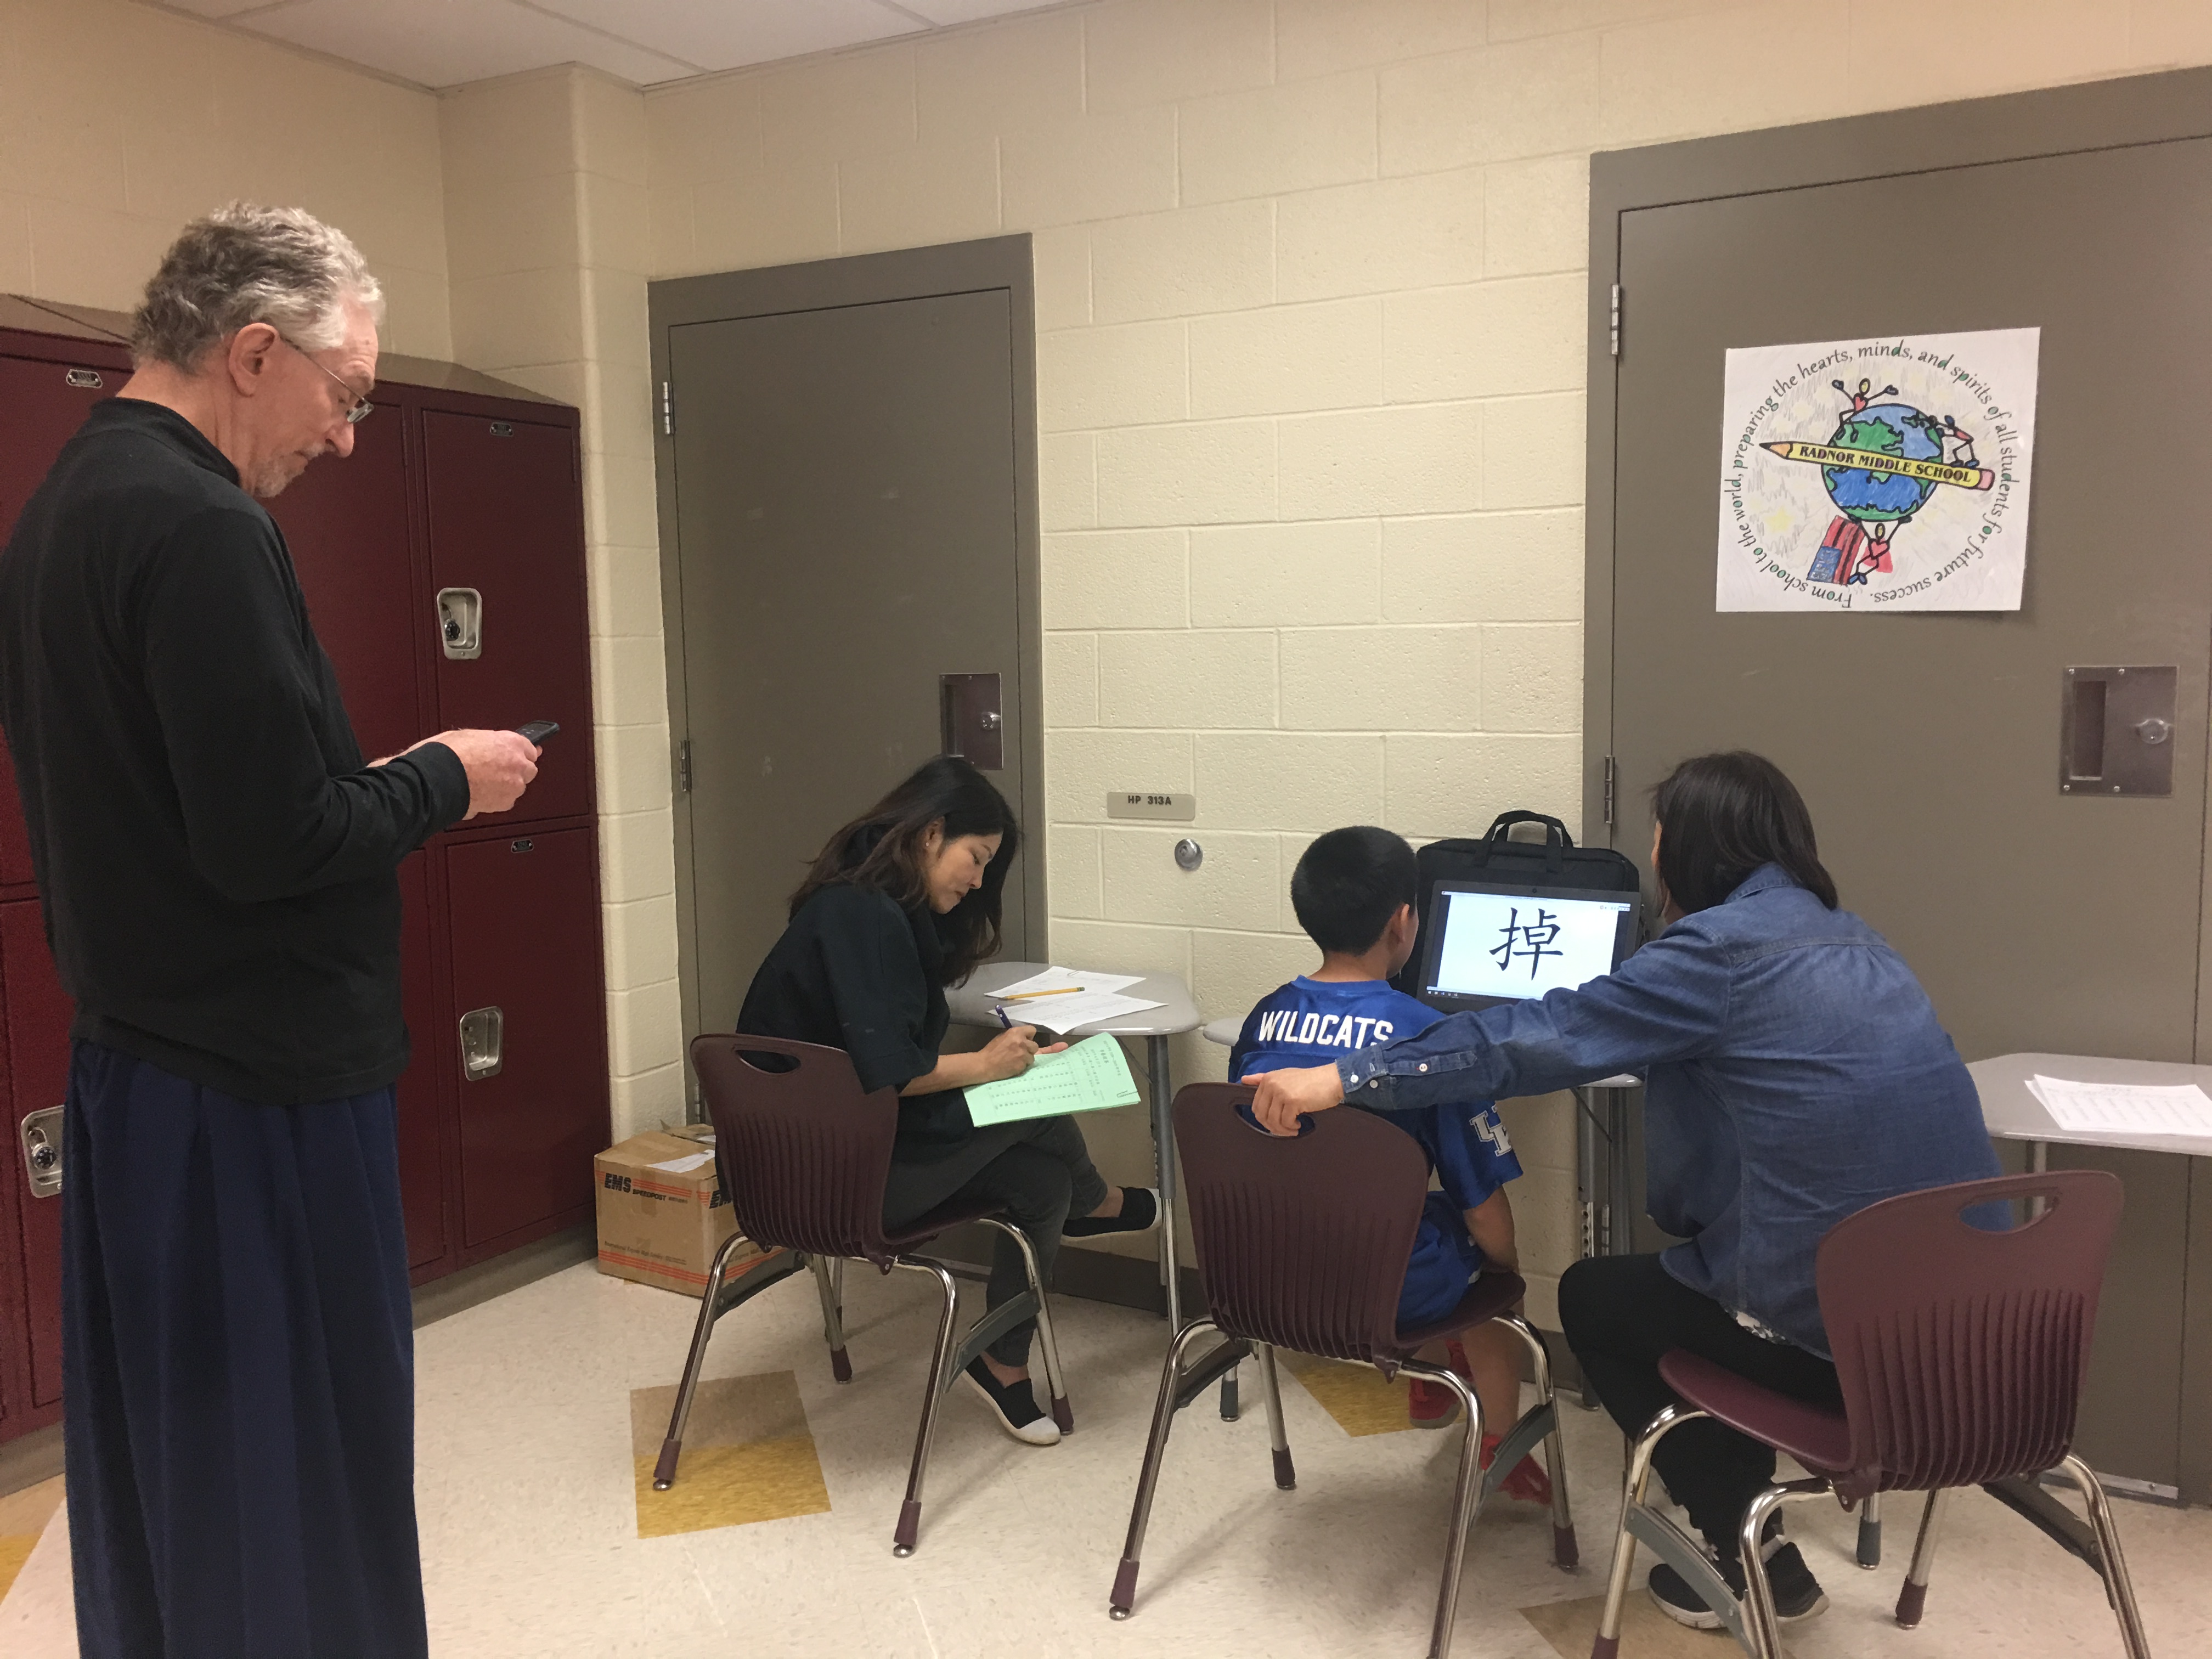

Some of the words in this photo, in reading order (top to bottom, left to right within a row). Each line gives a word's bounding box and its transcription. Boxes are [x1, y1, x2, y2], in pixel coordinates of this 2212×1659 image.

[1858, 339, 1912, 359] minds,
[1917, 351, 1954, 370] and
[1797, 349, 1853, 379] hearts,
[1773, 379, 1798, 397] the
[1950, 366, 1992, 405] spirits
[1983, 406, 2012, 421] of
[1733, 396, 1779, 469] preparing
[1995, 424, 2019, 444] all
[1799, 445, 1855, 464] RADNOR
[1859, 455, 1911, 472] MIDDLE
[1915, 464, 1972, 482] SCHOOL
[1991, 447, 2020, 517] students
[1724, 473, 1746, 521] world,
[1737, 523, 1757, 548] the
[1978, 513, 2002, 544] for
[1753, 547, 1767, 564] to
[1934, 535, 1984, 582] future
[1760, 560, 1808, 592] school
[1812, 586, 1852, 608] From
[1870, 578, 1932, 602] success.
[1128, 795, 1141, 804] HP
[1147, 795, 1172, 805] 313A
[1489, 907, 1564, 980] 掉
[1258, 1010, 1393, 1049] WILDCATS
[604, 1173, 631, 1193] EMS
[633, 1189, 667, 1201] SPEEDPOST
